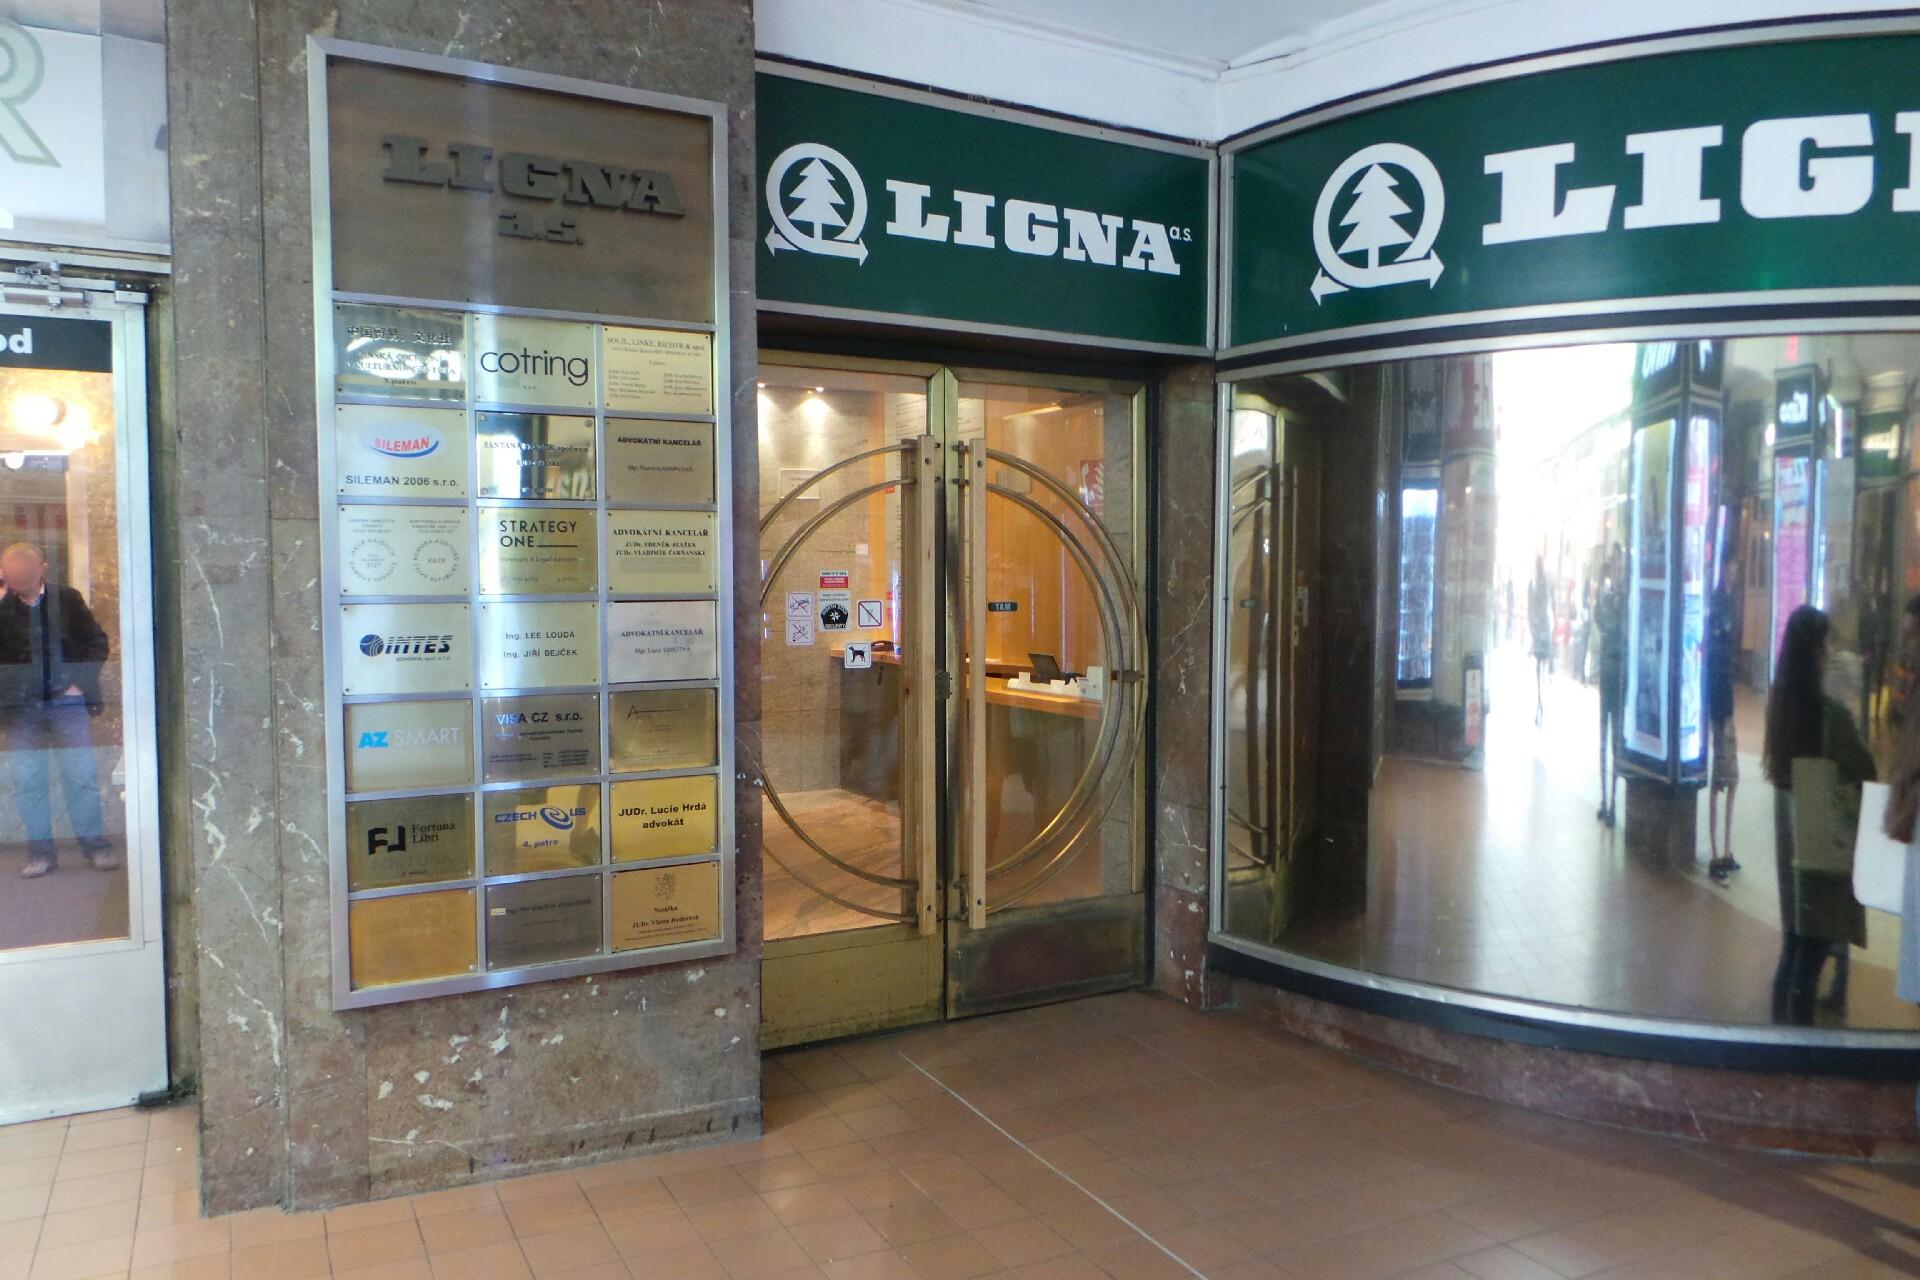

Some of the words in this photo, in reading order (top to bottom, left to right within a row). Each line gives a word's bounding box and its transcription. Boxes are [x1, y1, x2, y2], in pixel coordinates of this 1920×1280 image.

[382, 134, 686, 218] LIGNA
[1482, 112, 1920, 245] LIG
[886, 179, 1180, 275] LIGNA
[1170, 225, 1193, 241] a.s.
[480, 347, 589, 387] cotring
[374, 436, 430, 452] SILEMAN
[345, 474, 400, 486] SILEMAN
[403, 476, 430, 487] 2006
[499, 520, 578, 534] STRATEGY
[500, 535, 535, 548] ONE
[505, 632, 521, 641] Ing.
[525, 631, 542, 640] LEE
[545, 631, 576, 640] LOUDA
[531, 712, 549, 723] CZ
[555, 712, 583, 722] s.r.o.
[358, 731, 389, 749] AZ
[393, 727, 460, 747] SMART
[618, 807, 648, 817] JUDr.
[650, 804, 679, 815] Lucie
[682, 802, 707, 812] Hrdá
[495, 811, 538, 824] CZECH
[642, 818, 685, 829] advokát
[412, 822, 456, 834] Fortuna
[412, 833, 439, 844] Libri
[534, 839, 560, 849] patro
